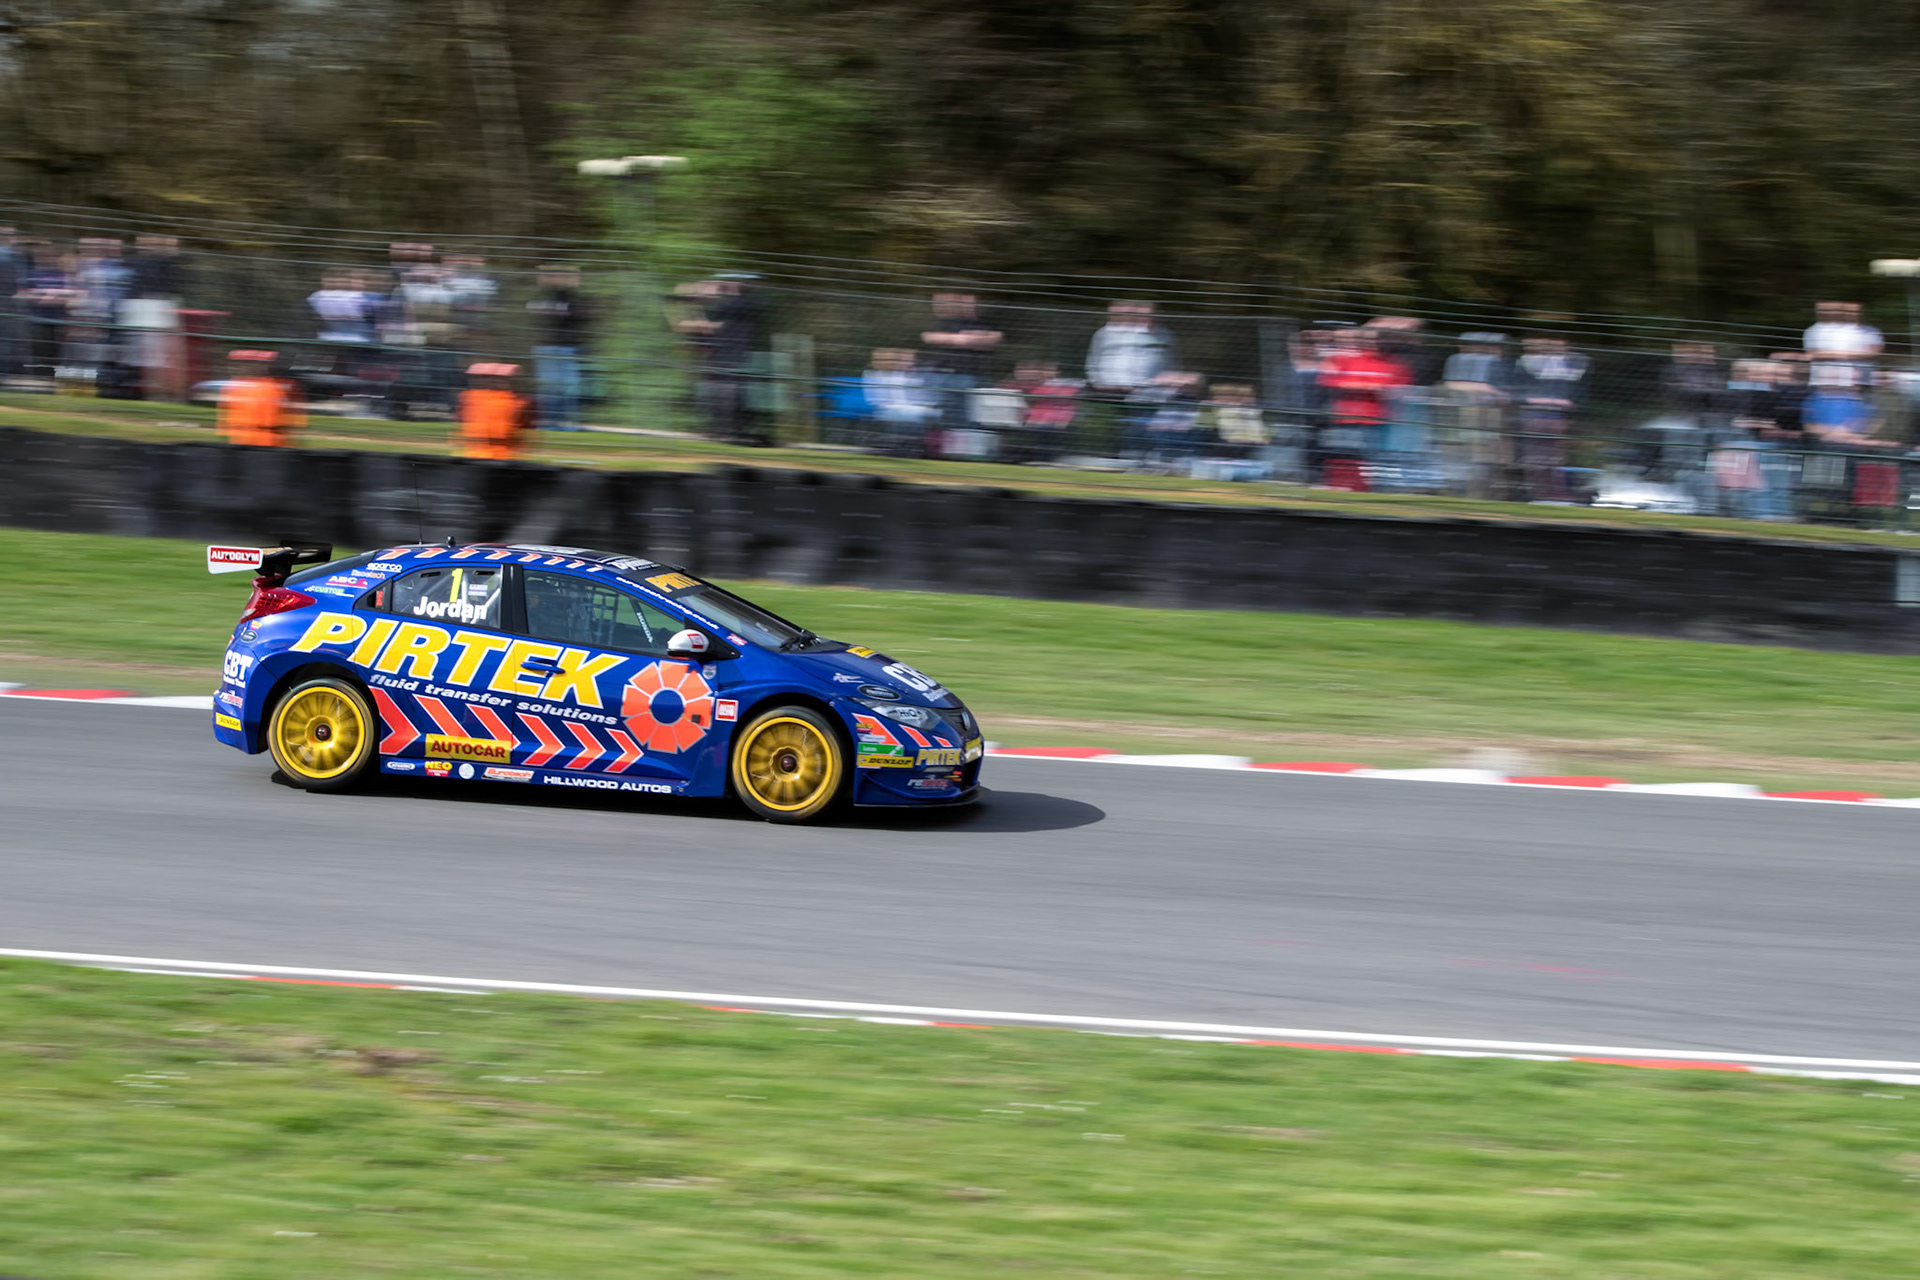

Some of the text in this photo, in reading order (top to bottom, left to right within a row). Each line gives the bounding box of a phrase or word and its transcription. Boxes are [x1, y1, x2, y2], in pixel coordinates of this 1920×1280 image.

[211, 550, 259, 561] AUTOGLYM
[367, 562, 403, 573] sparco
[328, 575, 358, 584] ABC
[449, 568, 464, 604] 1
[413, 596, 488, 620] Jordan
[223, 649, 255, 681] CBT
[288, 611, 630, 709] PIRTEK
[368, 673, 618, 726] fluid transfer solutions
[431, 740, 507, 759] AUTOCAR
[424, 761, 453, 770] NEO
[868, 756, 913, 766] DUNLOP
[543, 775, 619, 790] HILLWOOD
[619, 781, 673, 794] AUTOS
